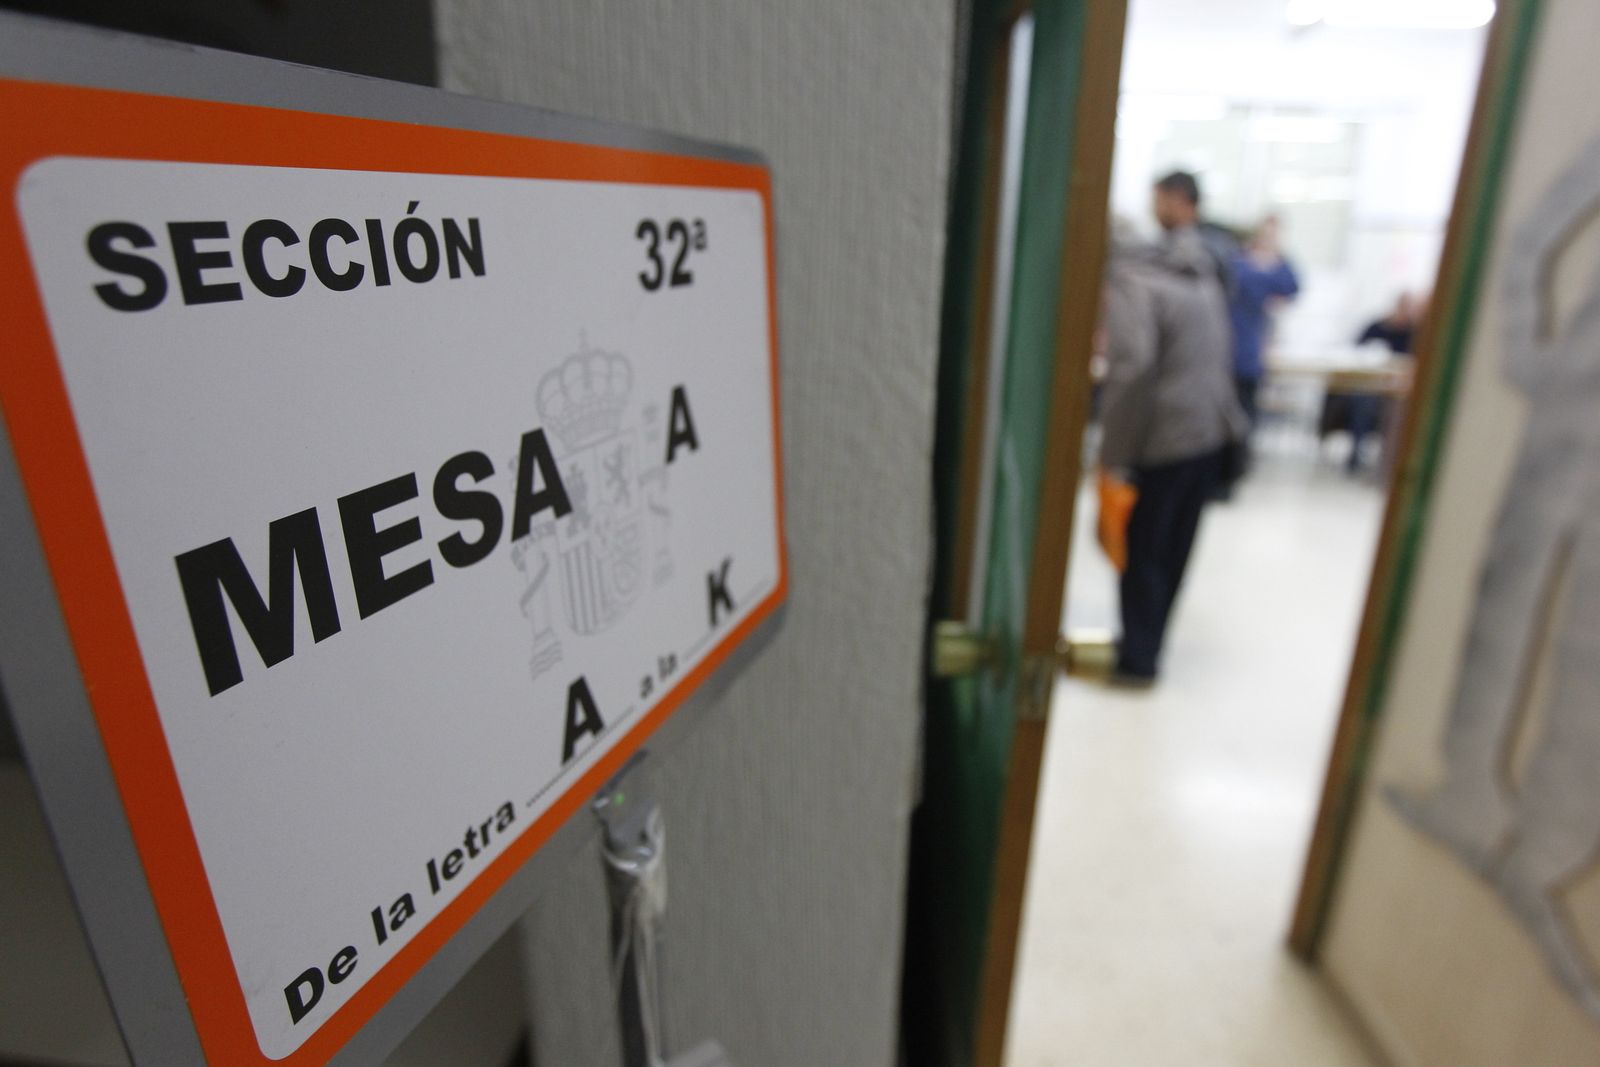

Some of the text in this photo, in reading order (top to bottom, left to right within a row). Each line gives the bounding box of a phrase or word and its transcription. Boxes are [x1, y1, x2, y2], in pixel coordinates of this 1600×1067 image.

[85, 200, 486, 313] SECCIÓN
[173, 385, 699, 698] MESA A
[283, 557, 734, 1026] De la letra A a la K
